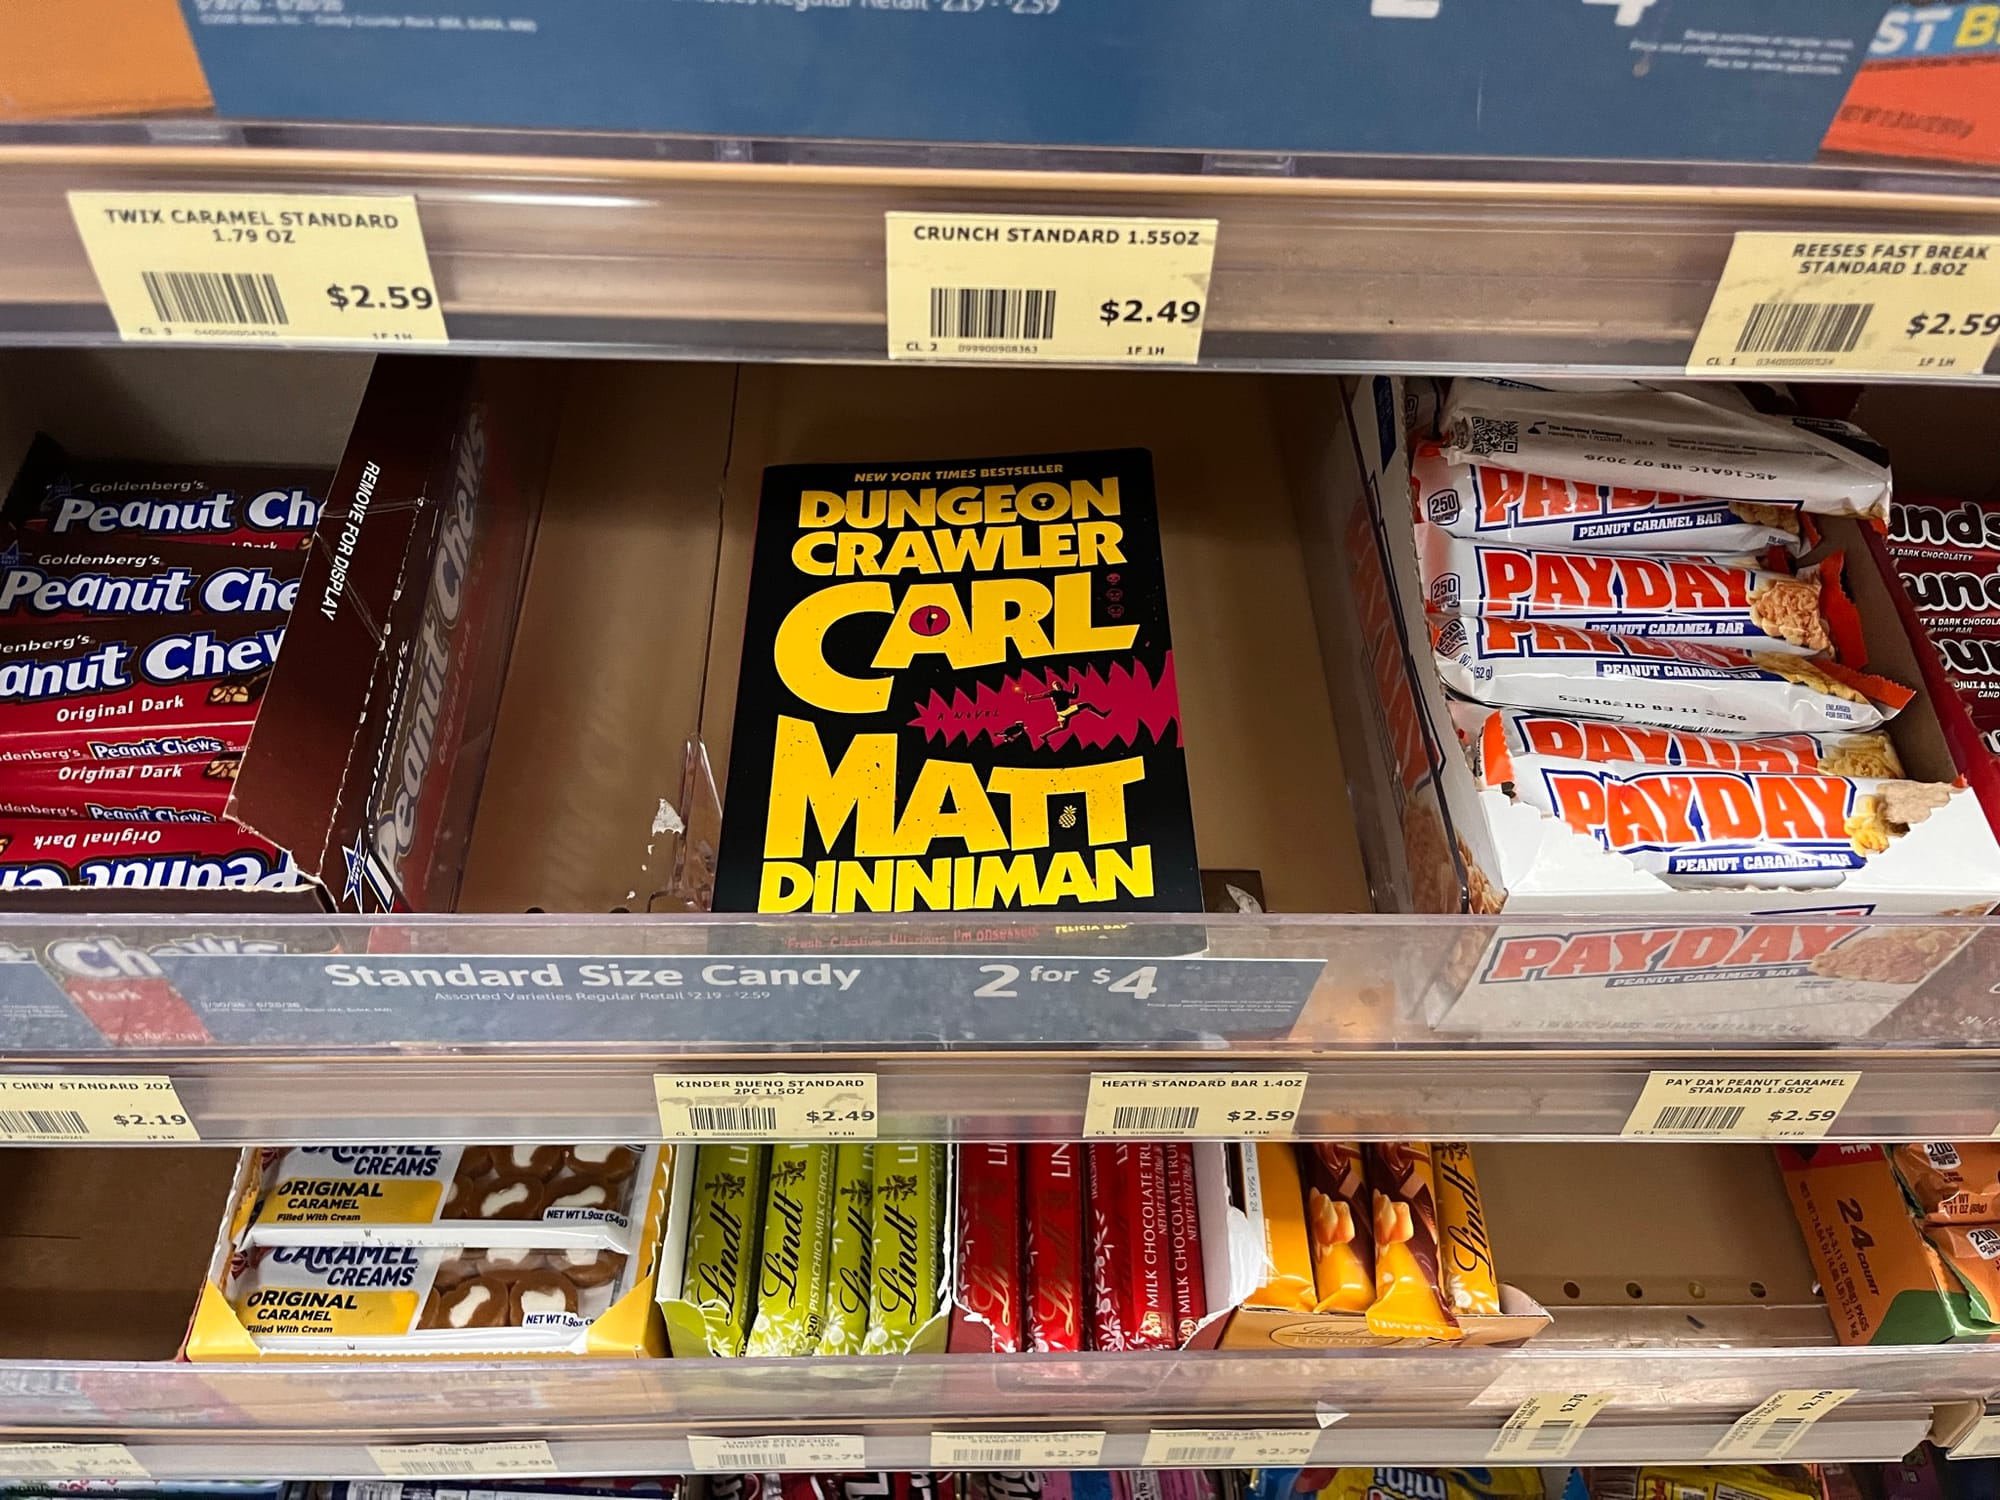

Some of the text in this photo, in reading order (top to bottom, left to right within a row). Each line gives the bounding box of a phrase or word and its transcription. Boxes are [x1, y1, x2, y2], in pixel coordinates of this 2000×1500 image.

[104, 208, 400, 230] TWIX CARAMEL STANDARD
[212, 228, 296, 244] 1.79 OZ
[913, 225, 1200, 246] CRUNCH STANDARD 1.55OZ
[1792, 243, 1991, 260] REESES FAST BREAK
[1797, 260, 1969, 277] STANDARD 1.8OZ
[326, 283, 435, 312] $2.59
[1099, 298, 1202, 327] $2.49
[1905, 311, 2000, 340] $2.59
[905, 342, 939, 352] CL 2
[1126, 346, 1165, 356] 1F 1H
[1705, 357, 1723, 367] CL
[854, 463, 1064, 483] NEW YORK TIMES BESTSELLER
[89, 479, 205, 494] Goldenberg's
[53, 492, 236, 533] Peanut
[798, 476, 1121, 530] DUNGEON
[1431, 493, 1457, 514] 250
[1578, 512, 1723, 539] PEANUT CARAMEL BAR
[320, 460, 381, 621] REMOVE FOR DISPLAY
[791, 520, 1128, 577] CRAWLER
[38, 553, 162, 568] Goldenberg's
[1897, 548, 1974, 562] DARK CHOCOLATEY
[0, 568, 192, 613] Peanut
[1433, 577, 1458, 599] 250
[1483, 550, 1751, 612] PAYDAY
[1590, 621, 1745, 635] PEANUT CARAMEL BAR
[1937, 618, 1961, 627] DARK
[773, 571, 1141, 714] CARL
[1437, 620, 1461, 650] 250
[1473, 665, 1494, 680] (52 g)
[1602, 663, 1731, 680] PEANUT CARAMEL
[56, 695, 185, 723] Original Dark
[952, 709, 1000, 722] NOVEL
[93, 736, 223, 760] Peanut Chews
[57, 764, 183, 783] Original Dark
[763, 714, 1147, 859] MATT
[90, 805, 152, 823] Peanut
[1556, 775, 1854, 849] PAYDAY
[33, 828, 162, 849] Original Dark
[1675, 852, 1850, 874] PEANUT CARAMEL BAR
[757, 844, 1155, 914] DINNIMAN
[1488, 911, 1862, 981] PAYDAY
[325, 962, 862, 992] Standard Size Candy
[973, 963, 1158, 1001] 2 for $4
[1612, 967, 1800, 987] PEANUT CARAMEL BAR
[434, 990, 684, 1004] Assorted Varieties Regular Retail
[12, 1082, 173, 1090] CHEW STANDARD 2OZ
[676, 1079, 865, 1088] KINDER BUENO STANDARD
[733, 1087, 805, 1096] 2PC 1.5OZ
[1102, 1079, 1303, 1088] HEATH STANDARD BAR 1.4OZ
[1665, 1078, 1846, 1087] PAY DAY PEANUT CARAMEL
[1688, 1086, 1813, 1095] STANDARD 1.85OZ
[113, 1114, 188, 1128] $2.19
[805, 1110, 876, 1123] $2.49
[1226, 1109, 1296, 1123] $2.59
[1767, 1109, 1837, 1123] $2.59
[1927, 1143, 1954, 1157] 200
[353, 1155, 440, 1177] CREAMS
[277, 1181, 384, 1198] ORIGINAL
[287, 1198, 360, 1210] CARAMEL
[276, 1212, 361, 1223] Filled With Cream
[546, 1209, 628, 1230] NET WT 1.9oz (54g)
[1157, 1202, 1167, 1236] NET WT
[1187, 1210, 1198, 1241] NET WT
[1440, 1162, 1497, 1288] Lindt
[1140, 1174, 1161, 1308] MILK CHOCOLATE
[1170, 1179, 1191, 1314] MILK CHOCOLATE
[1836, 1197, 1880, 1297] 24 COUNT
[1970, 1229, 1998, 1247] 200
[761, 1188, 805, 1311] Lindt
[273, 1246, 419, 1276] CARAMEL
[697, 1199, 744, 1327] Lindt
[808, 1211, 828, 1314] PISTACHIO MILK
[878, 1203, 919, 1327] Lindt
[326, 1265, 416, 1287] CREAMS
[247, 1290, 358, 1310] ORIGINAL
[256, 1309, 332, 1322] CARAMEL
[526, 1314, 545, 1325] NET
[546, 1314, 561, 1326] WT
[247, 1324, 333, 1335] Filled With Cream
[1797, 1390, 1833, 1412] $2.79
[1044, 1449, 1099, 1458] $2.79
[1256, 1448, 1310, 1456] $2.79
